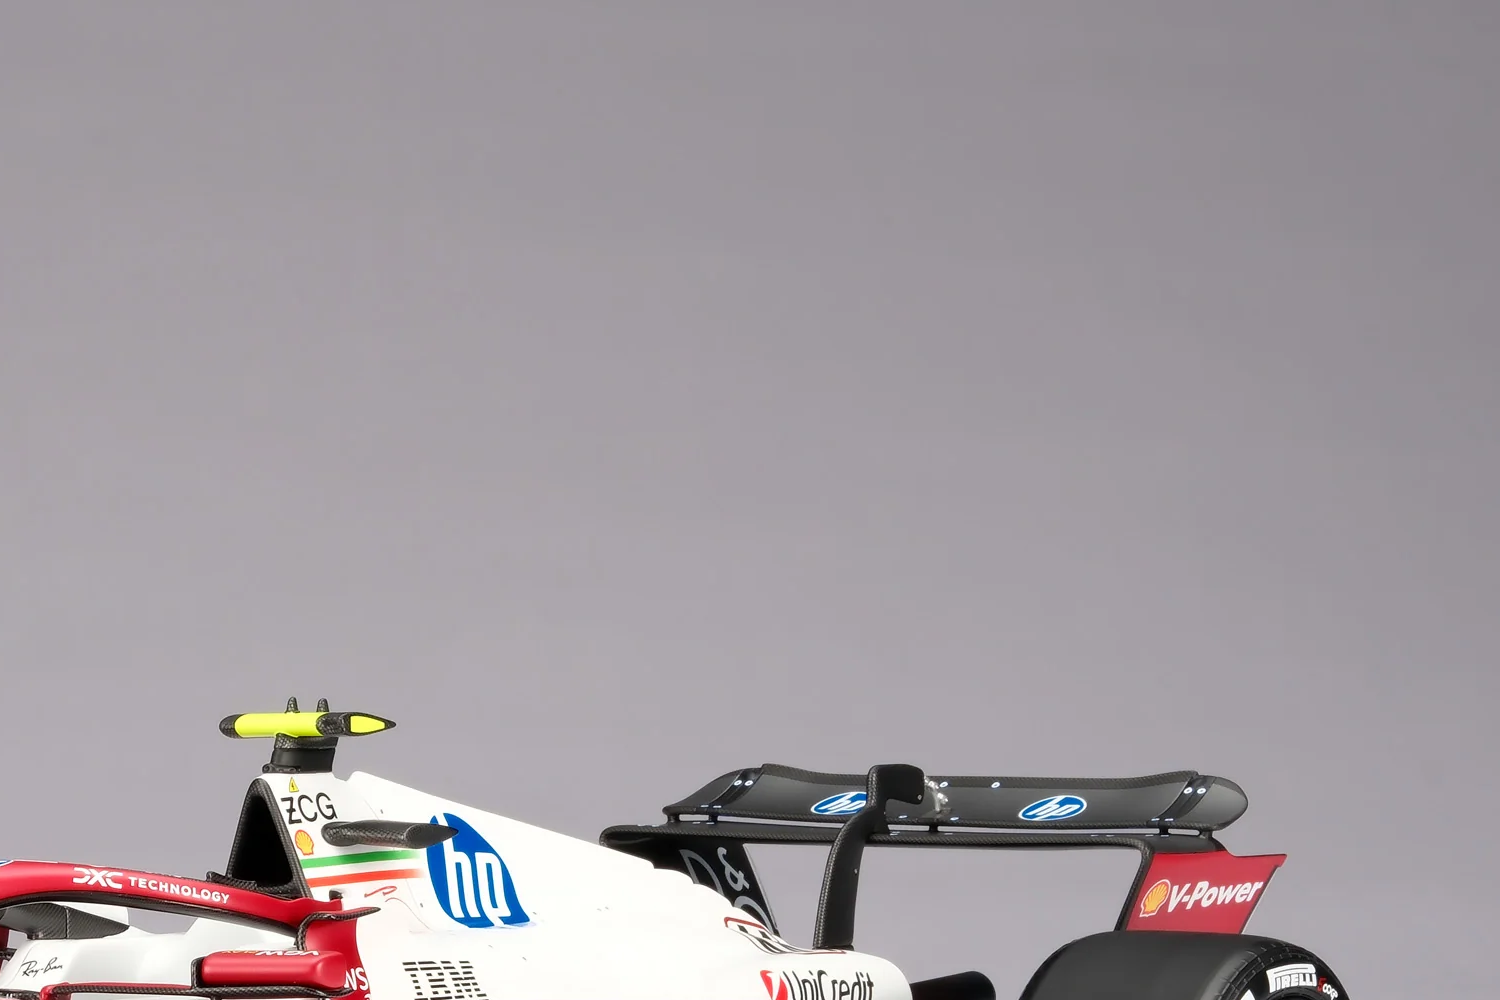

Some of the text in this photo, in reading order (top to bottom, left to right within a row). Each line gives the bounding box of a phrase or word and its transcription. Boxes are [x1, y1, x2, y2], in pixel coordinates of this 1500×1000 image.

[72, 867, 230, 904] DXC TECHNOLOGY
[433, 812, 514, 928] hp
[1167, 879, 1264, 914] V-Power
[1266, 963, 1317, 993] PIRELLI
